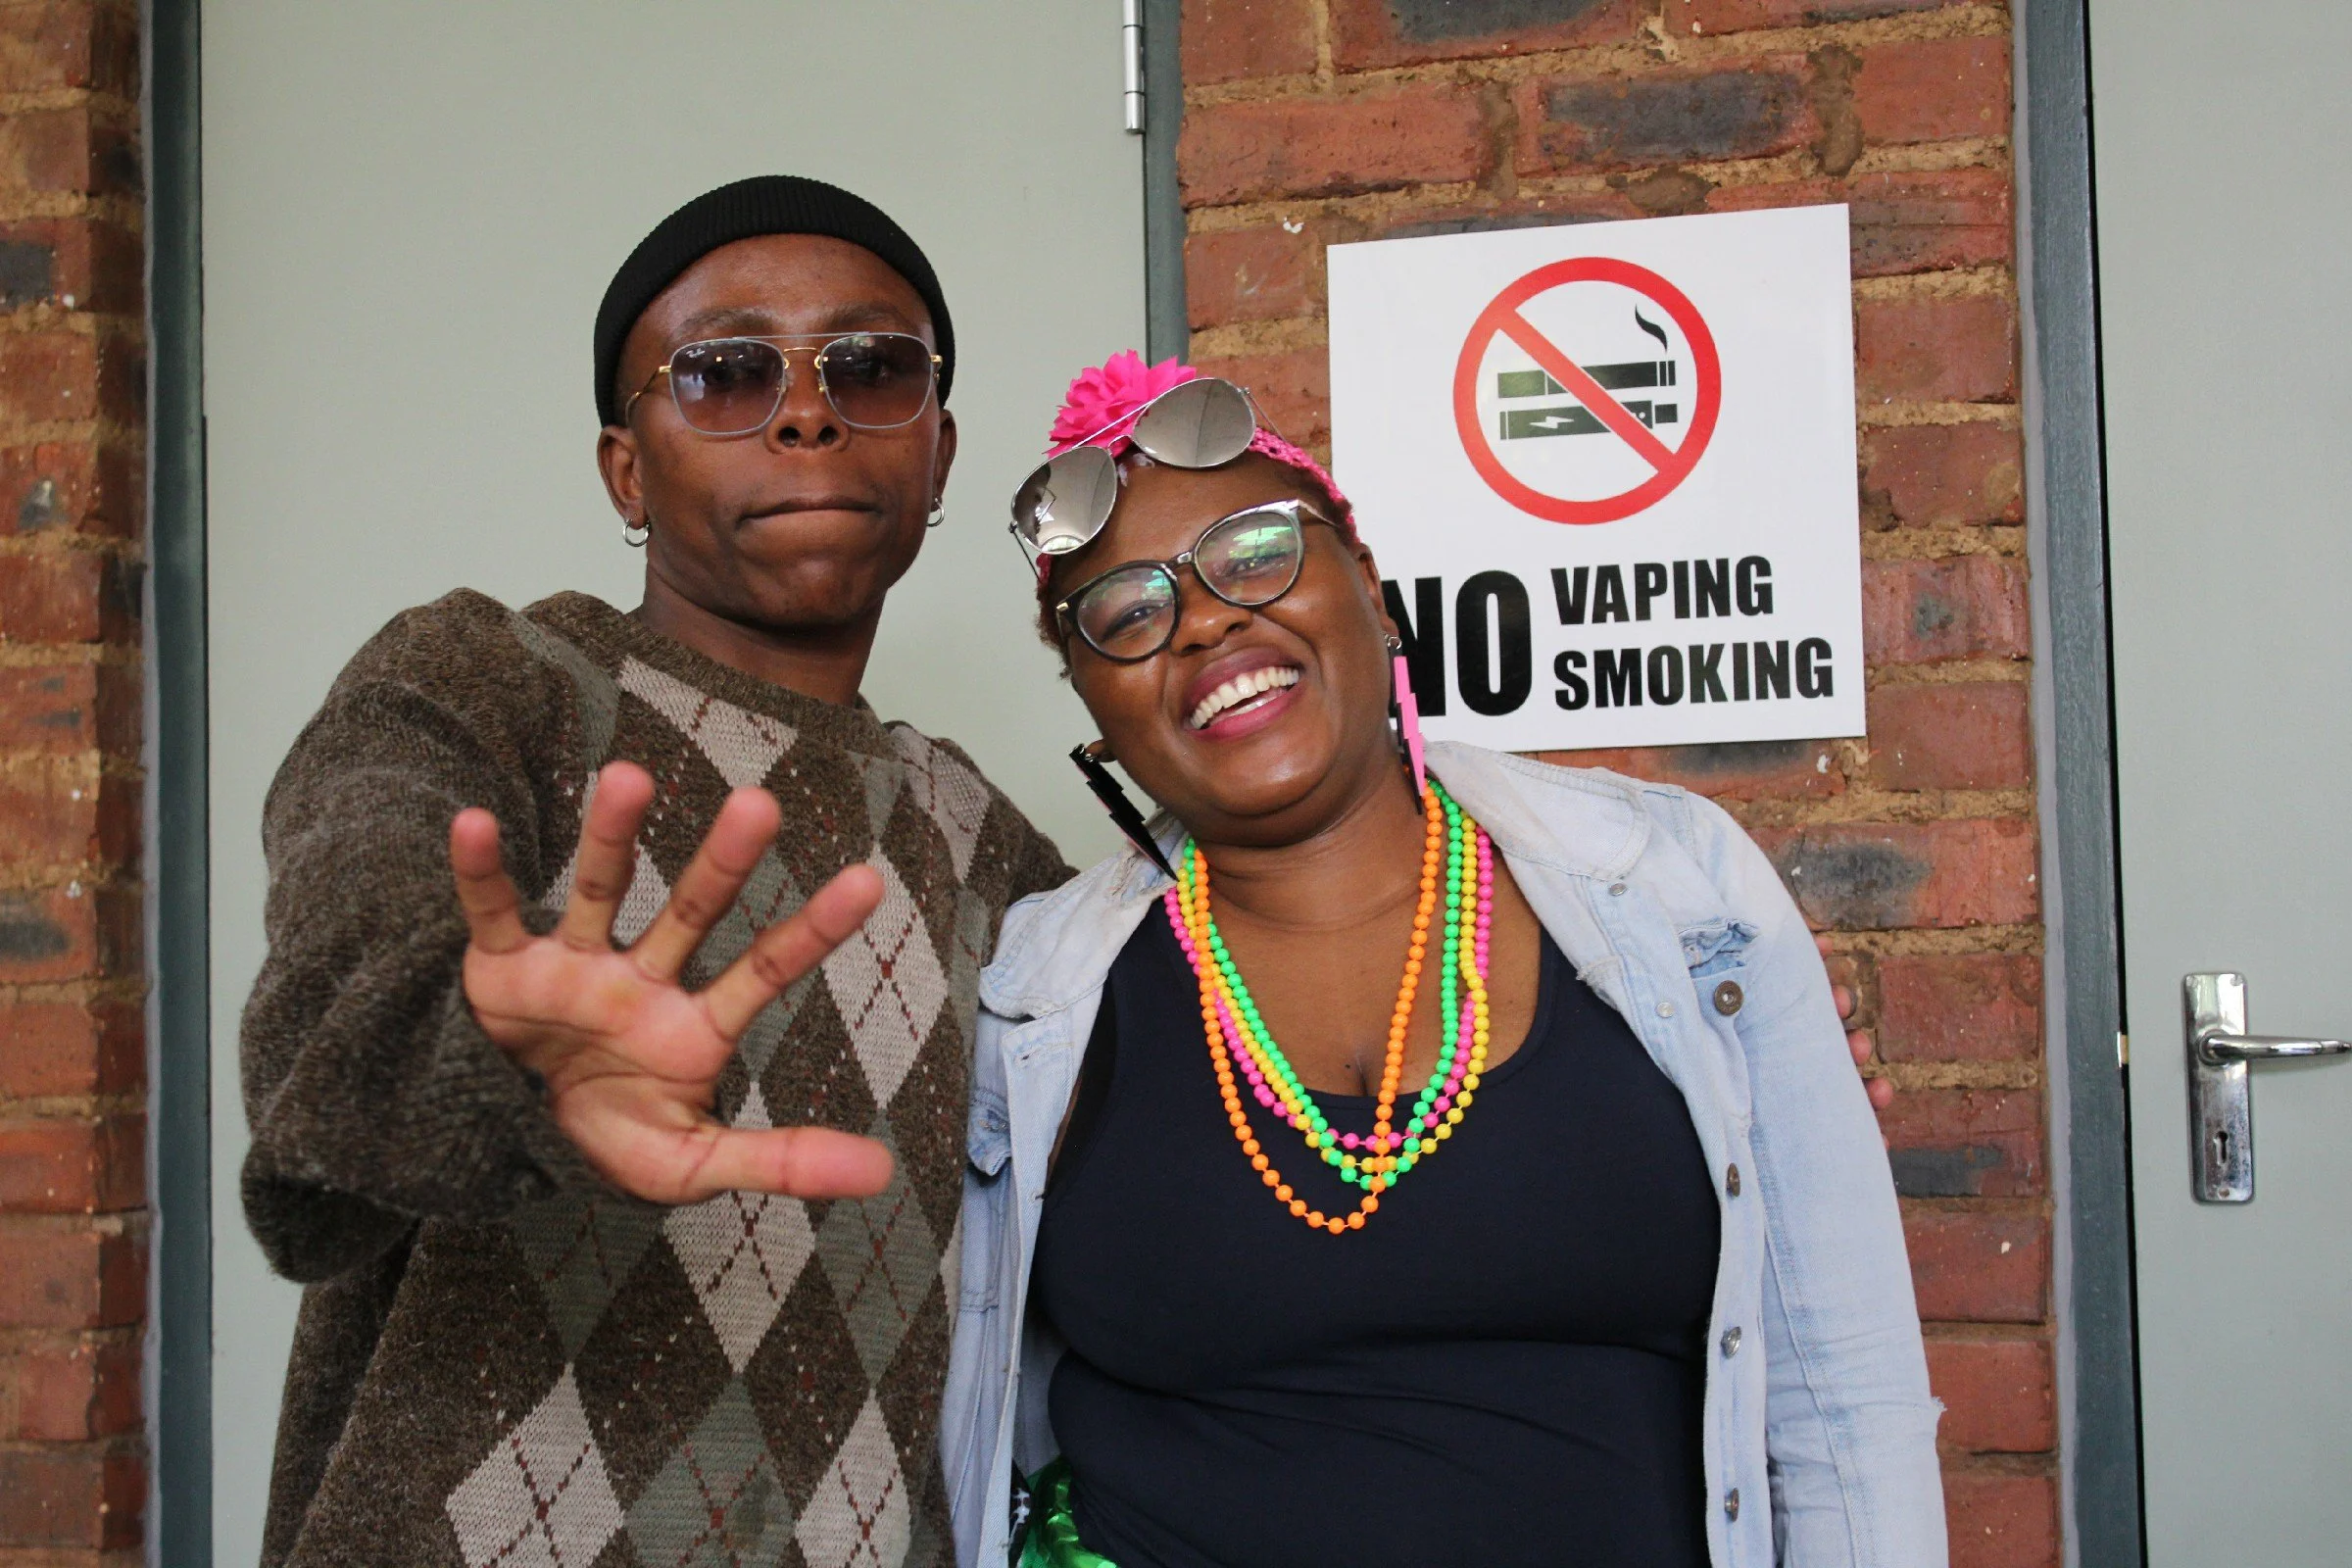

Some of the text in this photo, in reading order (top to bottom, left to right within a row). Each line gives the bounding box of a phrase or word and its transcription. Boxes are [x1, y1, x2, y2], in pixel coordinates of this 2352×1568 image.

[1550, 555, 1774, 625] VAPING
[1381, 570, 1533, 716] NO
[1553, 637, 1834, 711] SMOKING
